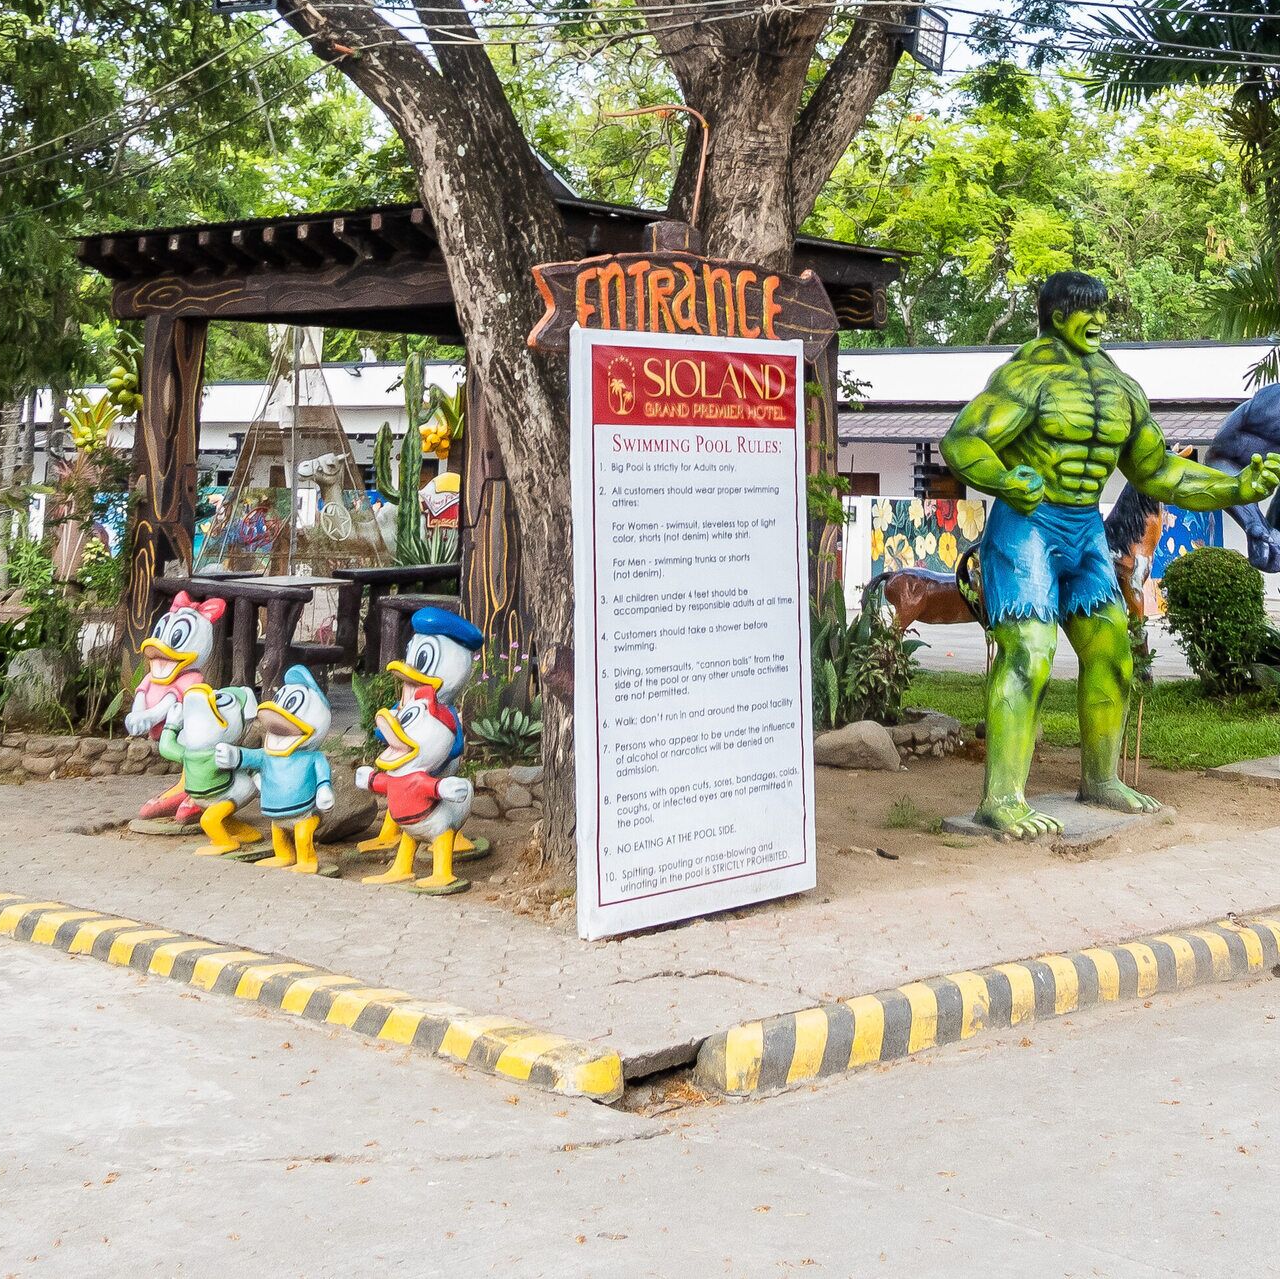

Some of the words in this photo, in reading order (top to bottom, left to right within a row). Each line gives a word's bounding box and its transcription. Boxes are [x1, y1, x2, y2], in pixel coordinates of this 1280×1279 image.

[643, 358, 787, 401] SIOLAND
[644, 402, 689, 418] GRAND
[693, 403, 744, 419] PREMIER
[747, 405, 786, 421] HOTEL
[611, 462, 624, 474] Big
[626, 462, 644, 472] Pool
[653, 462, 679, 474] strictly
[680, 462, 691, 472] for
[693, 463, 717, 472] Adults
[611, 486, 622, 496] All
[623, 486, 665, 495] customers
[667, 486, 693, 495] should
[717, 487, 742, 496] proper
[744, 485, 780, 495] swimming
[612, 521, 625, 532] For
[627, 521, 659, 531] Women
[702, 520, 736, 529] sleveless
[737, 519, 750, 530] top
[760, 518, 776, 529] light
[639, 533, 661, 543] shorts
[663, 532, 680, 544] (not
[681, 531, 709, 542] denim)
[711, 530, 733, 540] white
[612, 558, 626, 568] For
[627, 558, 646, 566] Men
[654, 555, 693, 566] swimming
[694, 554, 717, 564] trunks
[728, 553, 750, 563] shorts
[613, 569, 630, 581] (not
[613, 594, 623, 604] All
[626, 593, 659, 603] children
[661, 591, 686, 601] under
[694, 589, 709, 599] feet
[711, 587, 737, 598] should
[613, 603, 673, 616] accompanied
[688, 600, 731, 612] responsible
[732, 598, 755, 608] adults
[766, 597, 776, 606] all
[613, 630, 657, 641] Customers
[659, 626, 686, 639] should
[688, 625, 707, 635] take
[715, 623, 742, 633] shower
[743, 620, 768, 630] before
[754, 655, 771, 667] from
[772, 653, 785, 666] the
[614, 680, 631, 690] side
[645, 677, 658, 686] the
[660, 674, 679, 687] pool
[691, 674, 707, 683] any
[708, 670, 729, 680] other
[731, 667, 755, 678] unsafe
[757, 664, 789, 675] activities
[614, 694, 629, 703] are
[631, 690, 645, 700] not
[640, 713, 663, 724] don't
[665, 713, 678, 721] run
[688, 708, 705, 718] and
[707, 704, 735, 716] around
[737, 704, 749, 712] the
[751, 700, 769, 713] pool
[769, 698, 793, 708] facility
[615, 741, 646, 752] Persons
[648, 738, 666, 747] who
[668, 734, 698, 746] appear
[724, 728, 747, 738] under
[748, 726, 760, 738] the
[762, 721, 795, 732] influence
[626, 750, 658, 764] alcohol
[670, 744, 708, 757] narcotics
[709, 742, 722, 751] will
[736, 736, 763, 748] denied
[616, 791, 647, 803] Persons
[649, 787, 667, 797] with
[669, 784, 690, 795] open
[663, 794, 697, 808] infected
[699, 792, 718, 803] eyes
[720, 790, 733, 799] are
[734, 786, 746, 796] not
[748, 780, 786, 796] permitted
[617, 819, 631, 829] the
[634, 837, 664, 852] EATING
[678, 831, 691, 843] THE
[694, 828, 716, 840] POOL
[658, 858, 693, 874] spouting
[705, 846, 756, 863] nose-blowing
[758, 841, 773, 852] and
[620, 878, 658, 893] urinating
[669, 873, 683, 883] the
[685, 867, 703, 881] pool
[712, 859, 744, 874] STRICTLY
